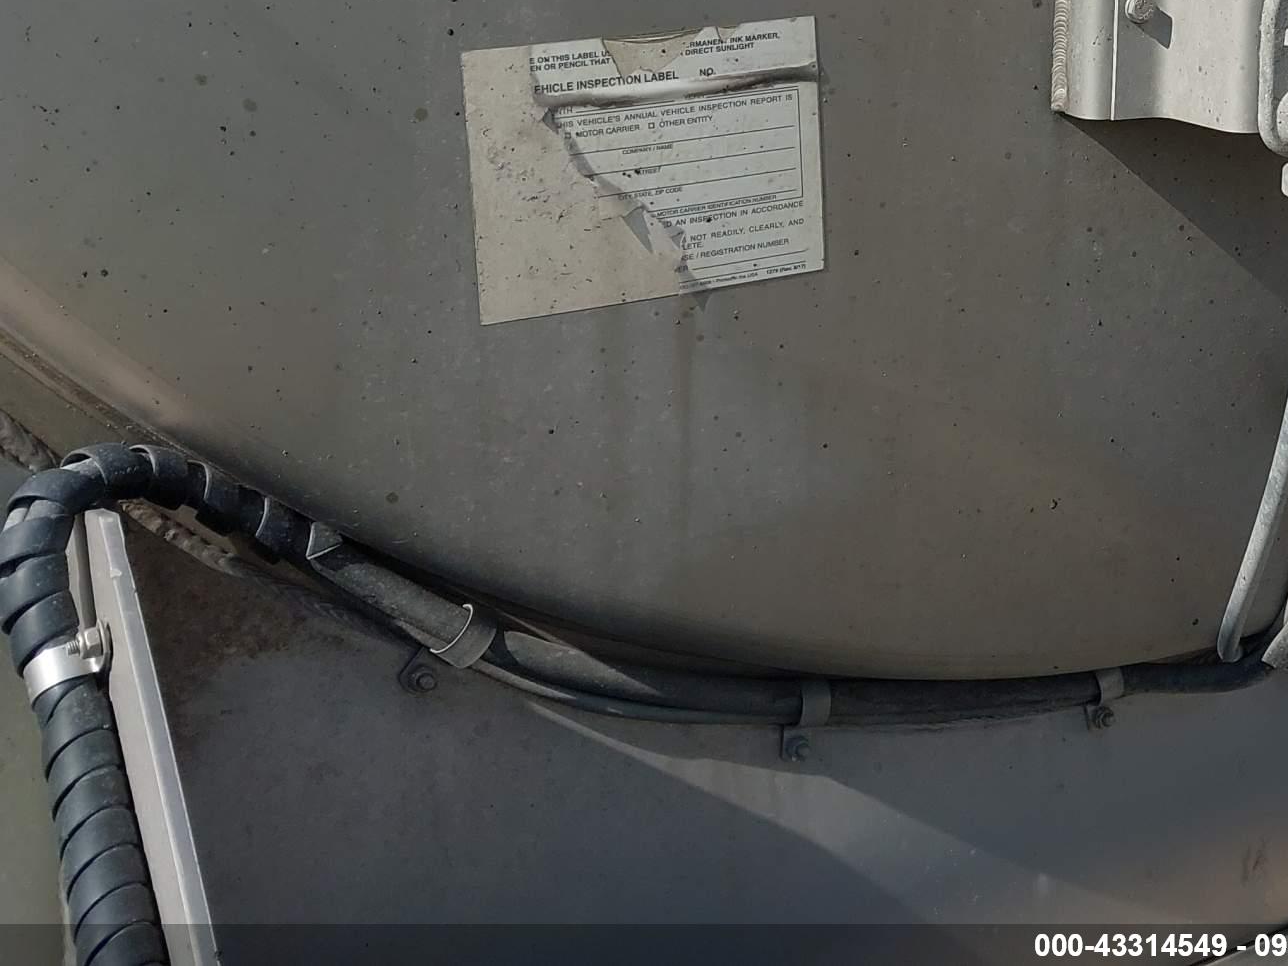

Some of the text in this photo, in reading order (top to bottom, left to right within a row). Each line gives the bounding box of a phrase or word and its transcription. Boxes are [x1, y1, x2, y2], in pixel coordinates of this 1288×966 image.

[543, 63, 556, 71] OR
[558, 59, 587, 69] PENCIL
[590, 57, 611, 66] THAT
[685, 47, 713, 56] DIRECT
[716, 42, 755, 52] SUNLIGHT
[551, 51, 570, 62] THIS
[571, 49, 599, 60] LABEL
[729, 35, 742, 44] INK
[577, 75, 641, 90] INSPECTION
[644, 70, 679, 82] LABEL
[623, 111, 657, 121] ANNUAL
[661, 106, 695, 116] VEHICLE
[698, 100, 747, 111] INSPECTION
[750, 95, 782, 105] REPORT
[606, 124, 640, 134] CARRIER
[659, 119, 685, 128] OTHER
[687, 115, 713, 123] ENTITY
[674, 218, 687, 226] AN
[690, 210, 737, 224] INSPECTION
[751, 201, 804, 214] ACCORDANCE
[680, 205, 706, 214] CARRIER
[707, 199, 750, 209] IDENTIFICATION
[750, 194, 777, 203] NUMBER
[690, 234, 707, 242] NOT
[788, 218, 804, 227] AND
[700, 244, 756, 258] REGISTRATION
[757, 238, 789, 249] NUMBER
